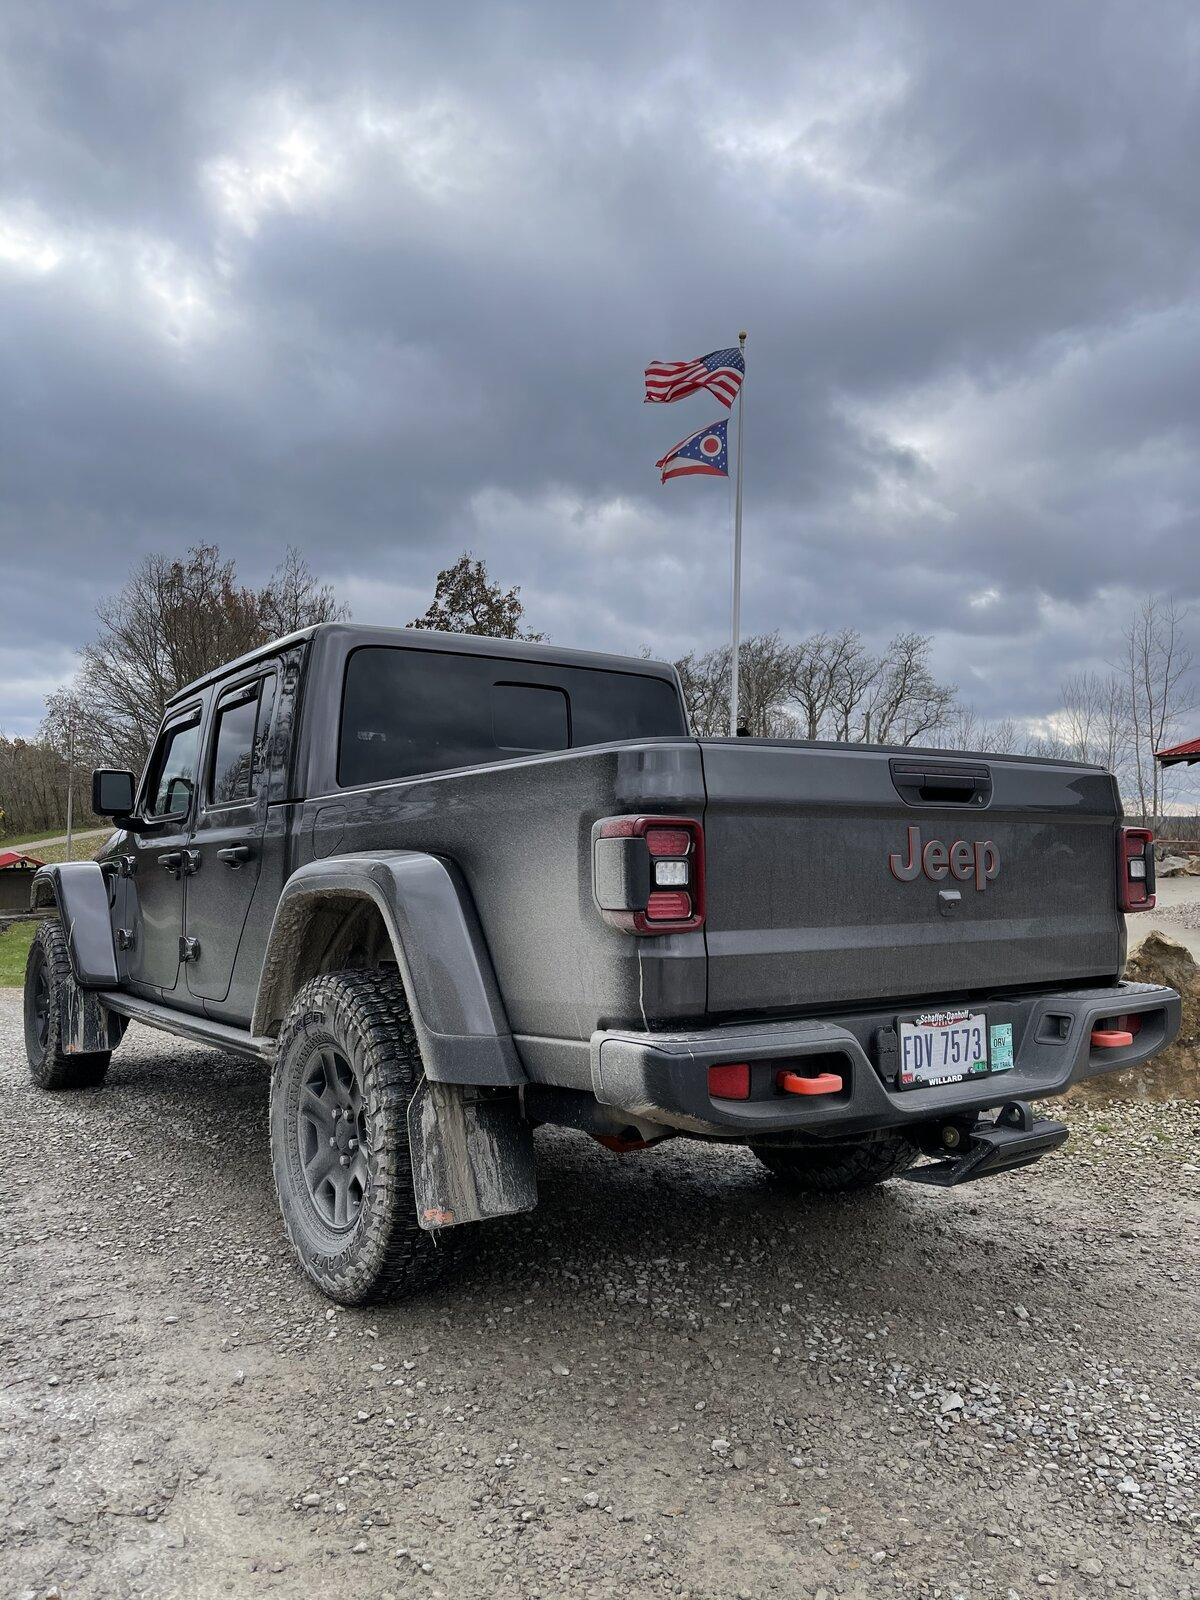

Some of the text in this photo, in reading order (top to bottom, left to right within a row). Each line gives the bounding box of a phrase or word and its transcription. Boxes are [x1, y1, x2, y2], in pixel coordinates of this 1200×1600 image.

[889, 826, 1000, 891] Jeep
[903, 1028, 982, 1070] FDV 7573
[993, 1037, 1006, 1048] ORV
[928, 1075, 963, 1086] WILLARD
